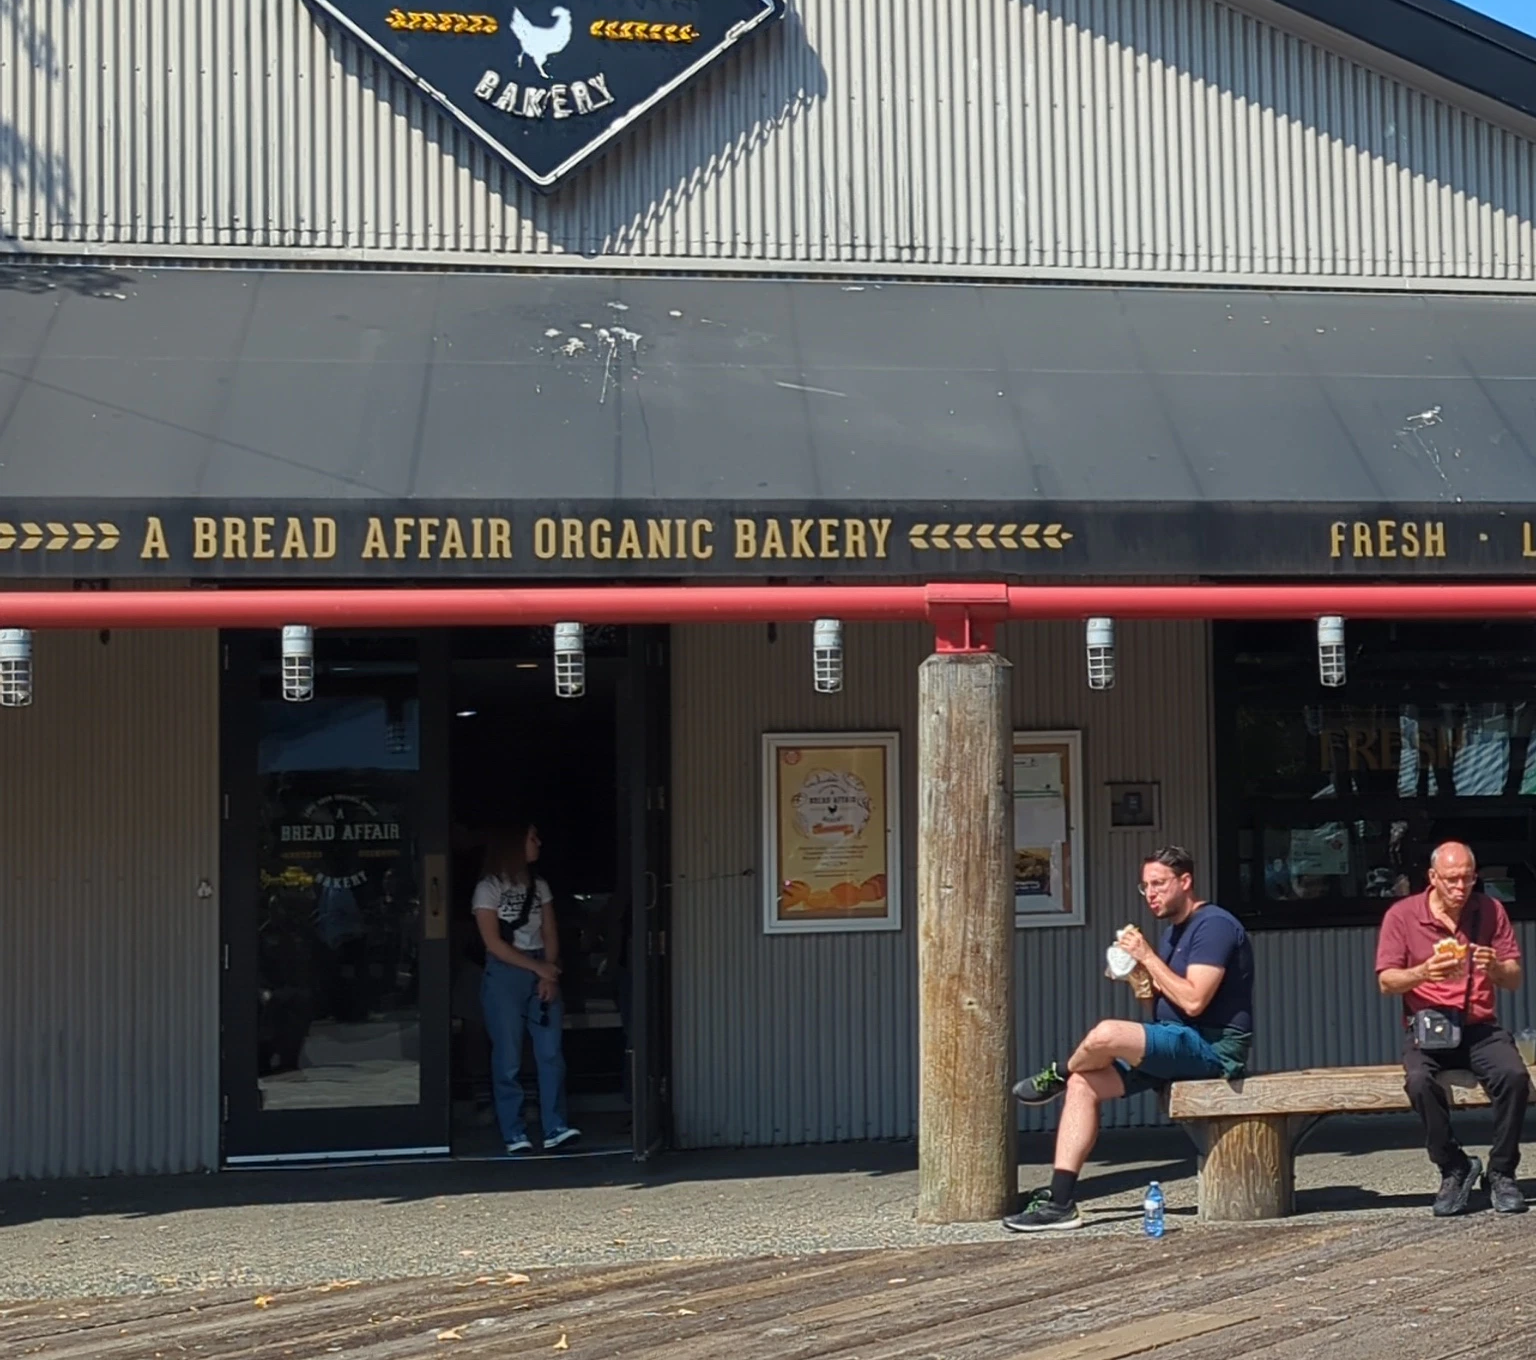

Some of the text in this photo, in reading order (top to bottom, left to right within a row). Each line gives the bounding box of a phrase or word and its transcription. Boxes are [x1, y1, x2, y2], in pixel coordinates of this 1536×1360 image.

[474, 70, 615, 119] BAKERY
[141, 517, 892, 559] A BREAD AFFAIR ORGANIC BAKERY
[1329, 520, 1446, 557] FRESH
[280, 823, 400, 842] BREAD AFFAIR
[316, 870, 368, 889] BAKERY
